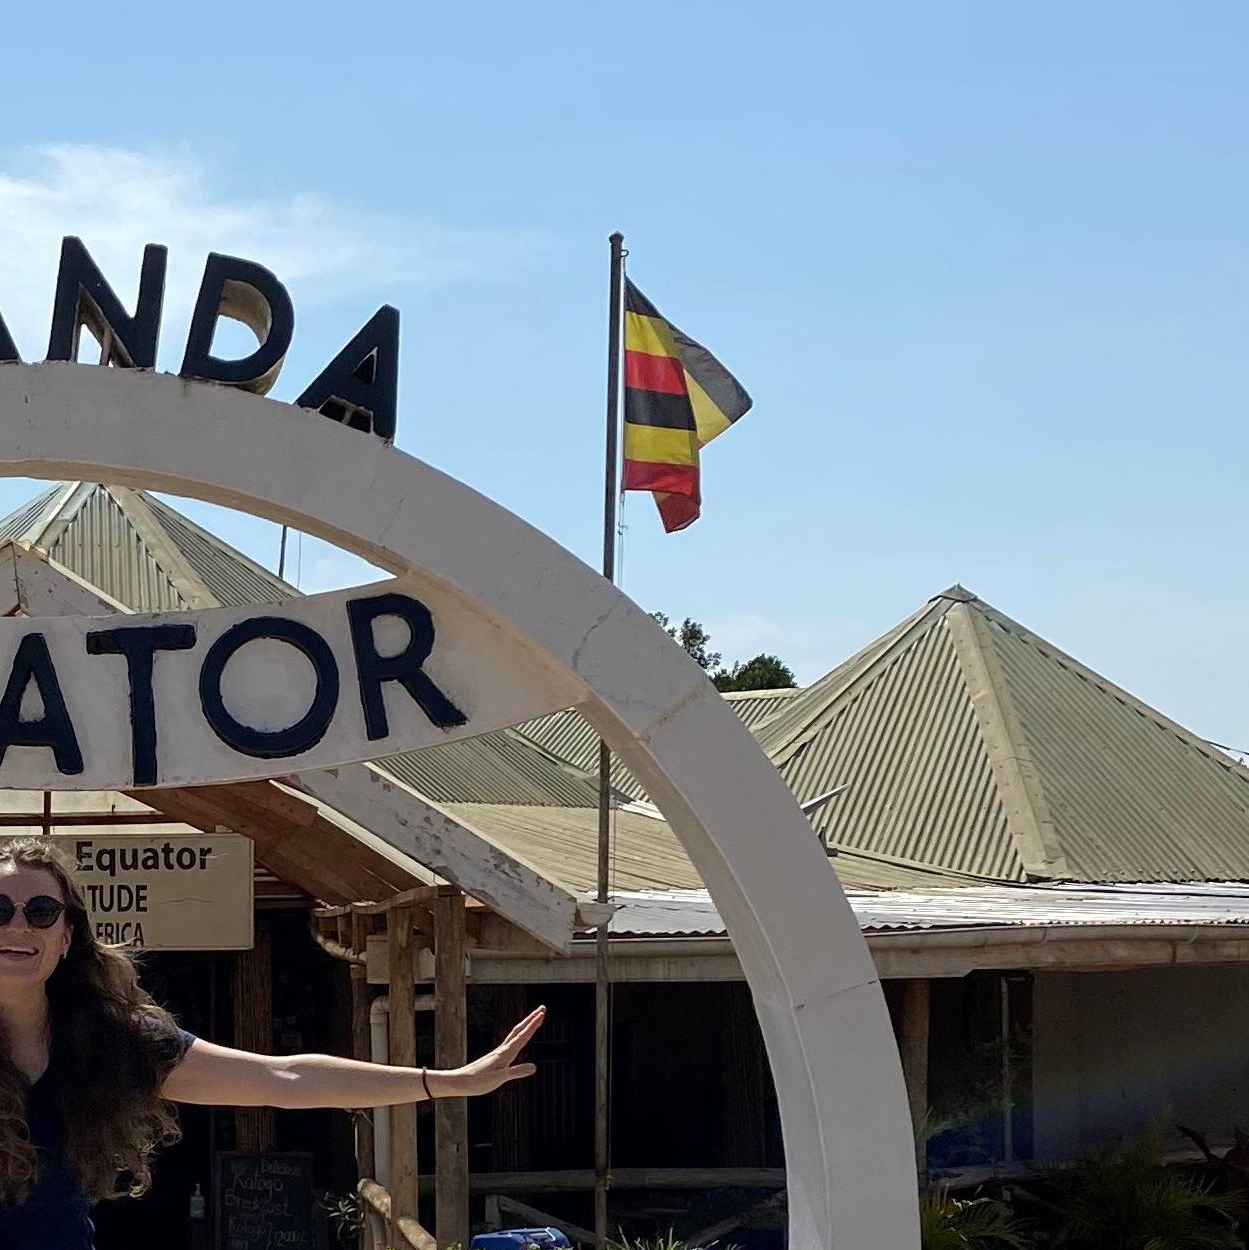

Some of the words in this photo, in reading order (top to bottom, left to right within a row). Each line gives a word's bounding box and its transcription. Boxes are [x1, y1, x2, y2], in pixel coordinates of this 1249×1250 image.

[76, 841, 212, 877] Equator
[86, 884, 148, 913] TUDE
[96, 922, 145, 947] FRICA
